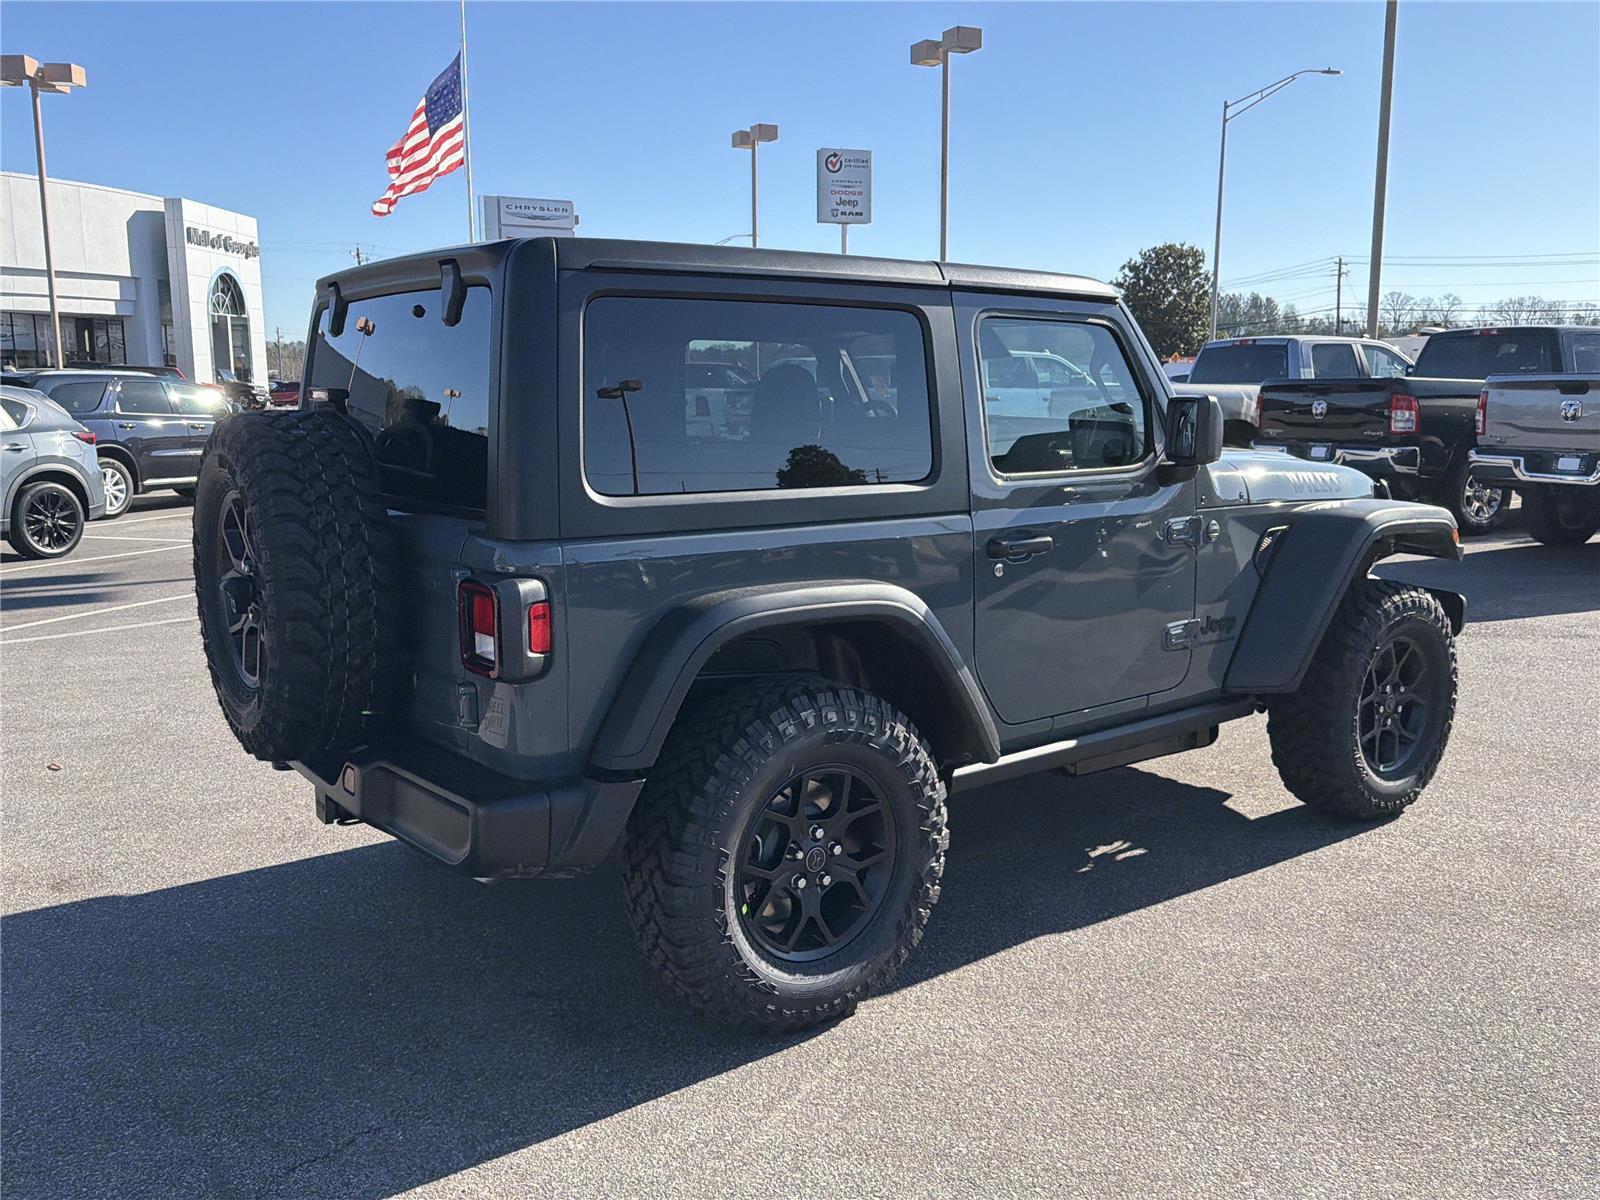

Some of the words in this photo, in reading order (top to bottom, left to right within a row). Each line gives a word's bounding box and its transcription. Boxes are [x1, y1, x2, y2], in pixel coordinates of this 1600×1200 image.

[505, 204, 569, 213] CHRYSLER
[835, 197, 859, 208] Jeep
[186, 226, 210, 247] Mall
[210, 233, 223, 250] of
[1285, 471, 1342, 494] WILLYS
[1200, 615, 1236, 635] Jeep
